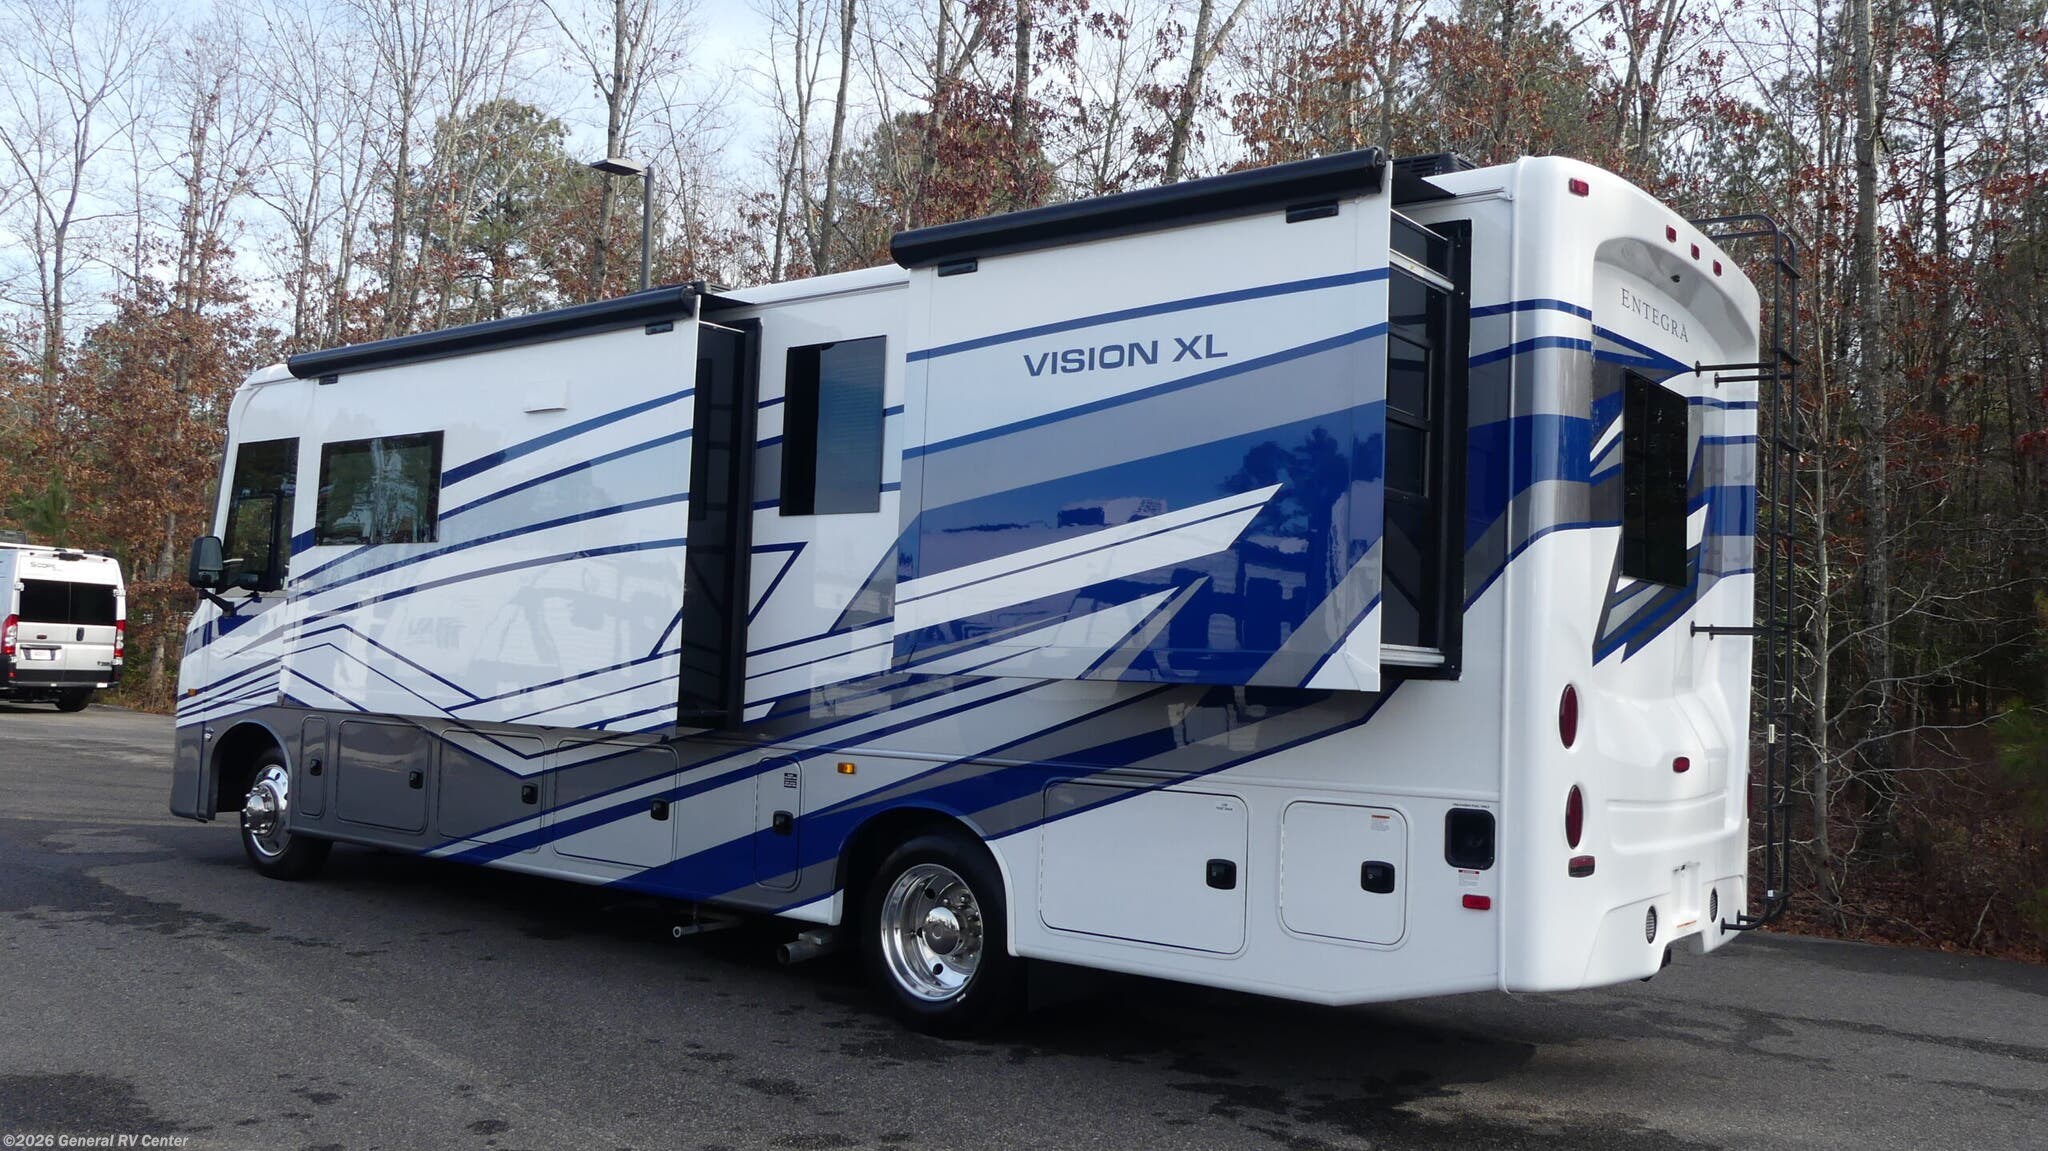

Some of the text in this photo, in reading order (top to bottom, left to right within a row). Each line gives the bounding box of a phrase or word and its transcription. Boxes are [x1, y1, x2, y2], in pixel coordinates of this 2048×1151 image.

[1620, 287, 1689, 343] ENTEGRA
[1023, 333, 1228, 377] VISION XL
